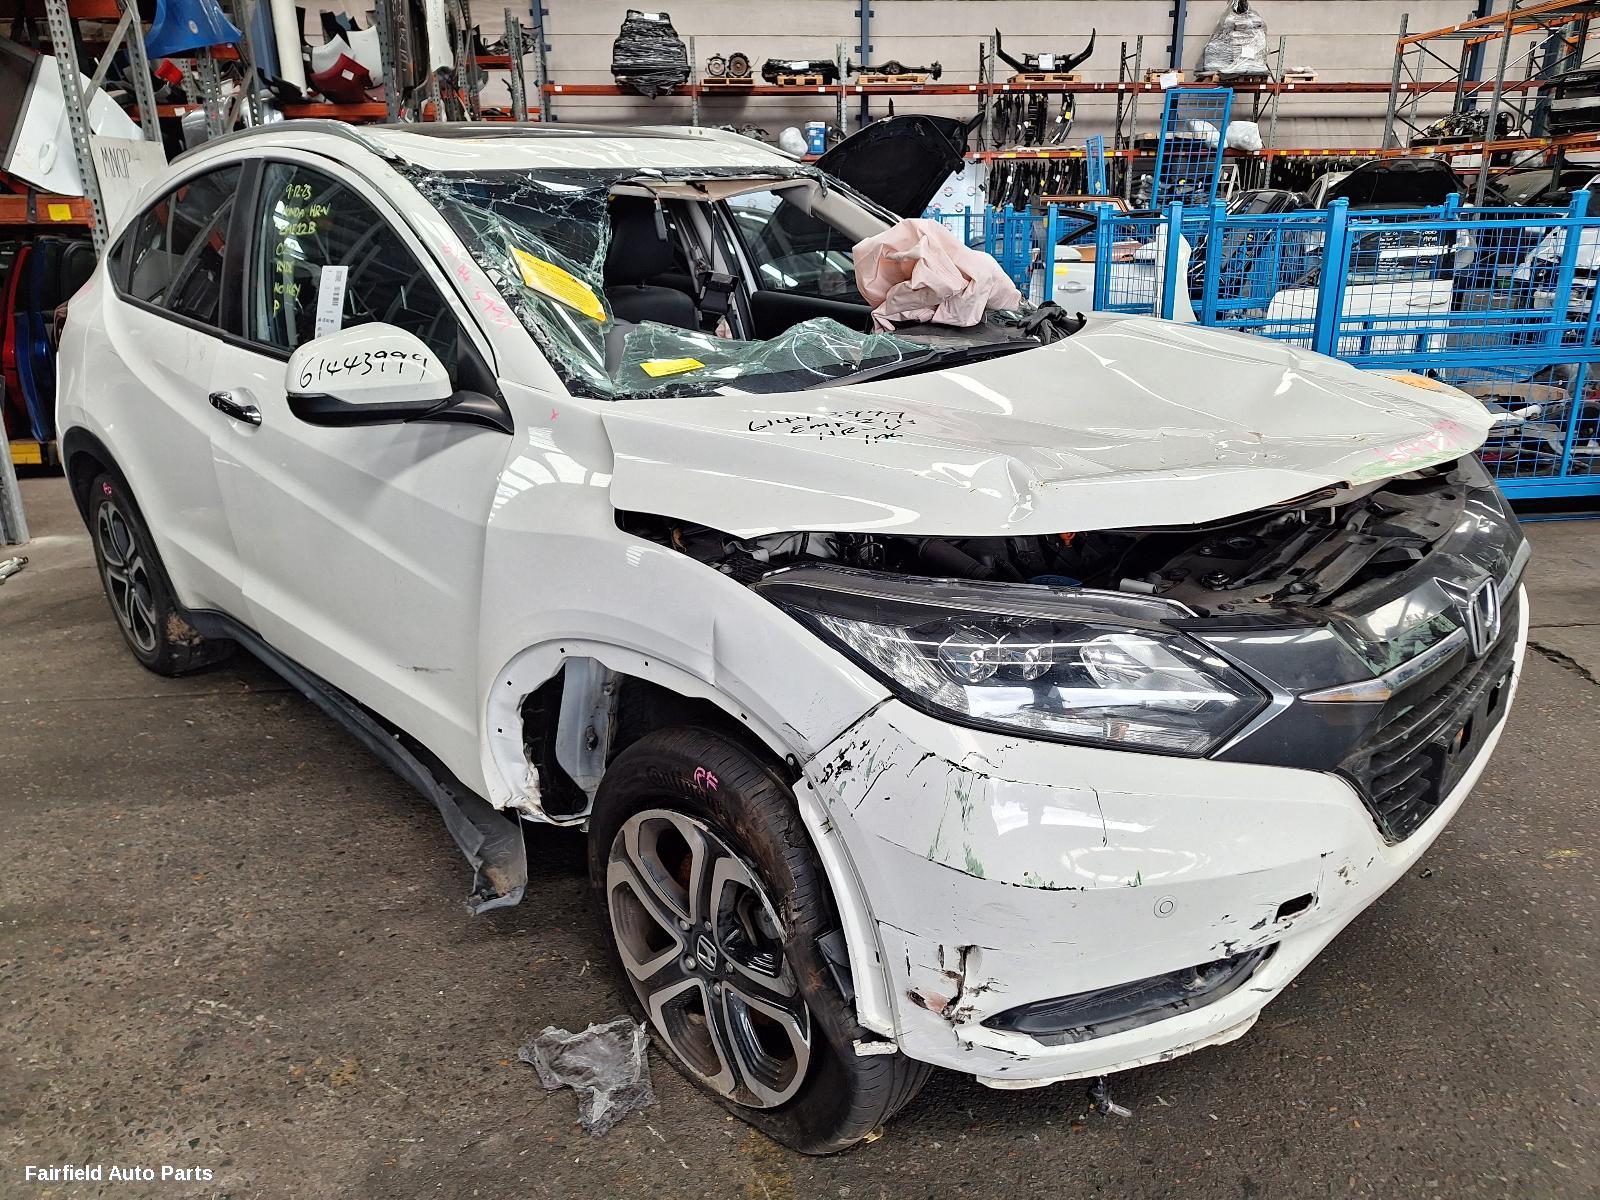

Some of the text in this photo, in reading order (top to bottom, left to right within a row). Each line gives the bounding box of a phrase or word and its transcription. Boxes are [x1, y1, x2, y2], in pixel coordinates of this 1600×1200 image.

[100, 146, 131, 179] MNOP
[299, 350, 428, 388] 61443999
[693, 766, 719, 793] RF
